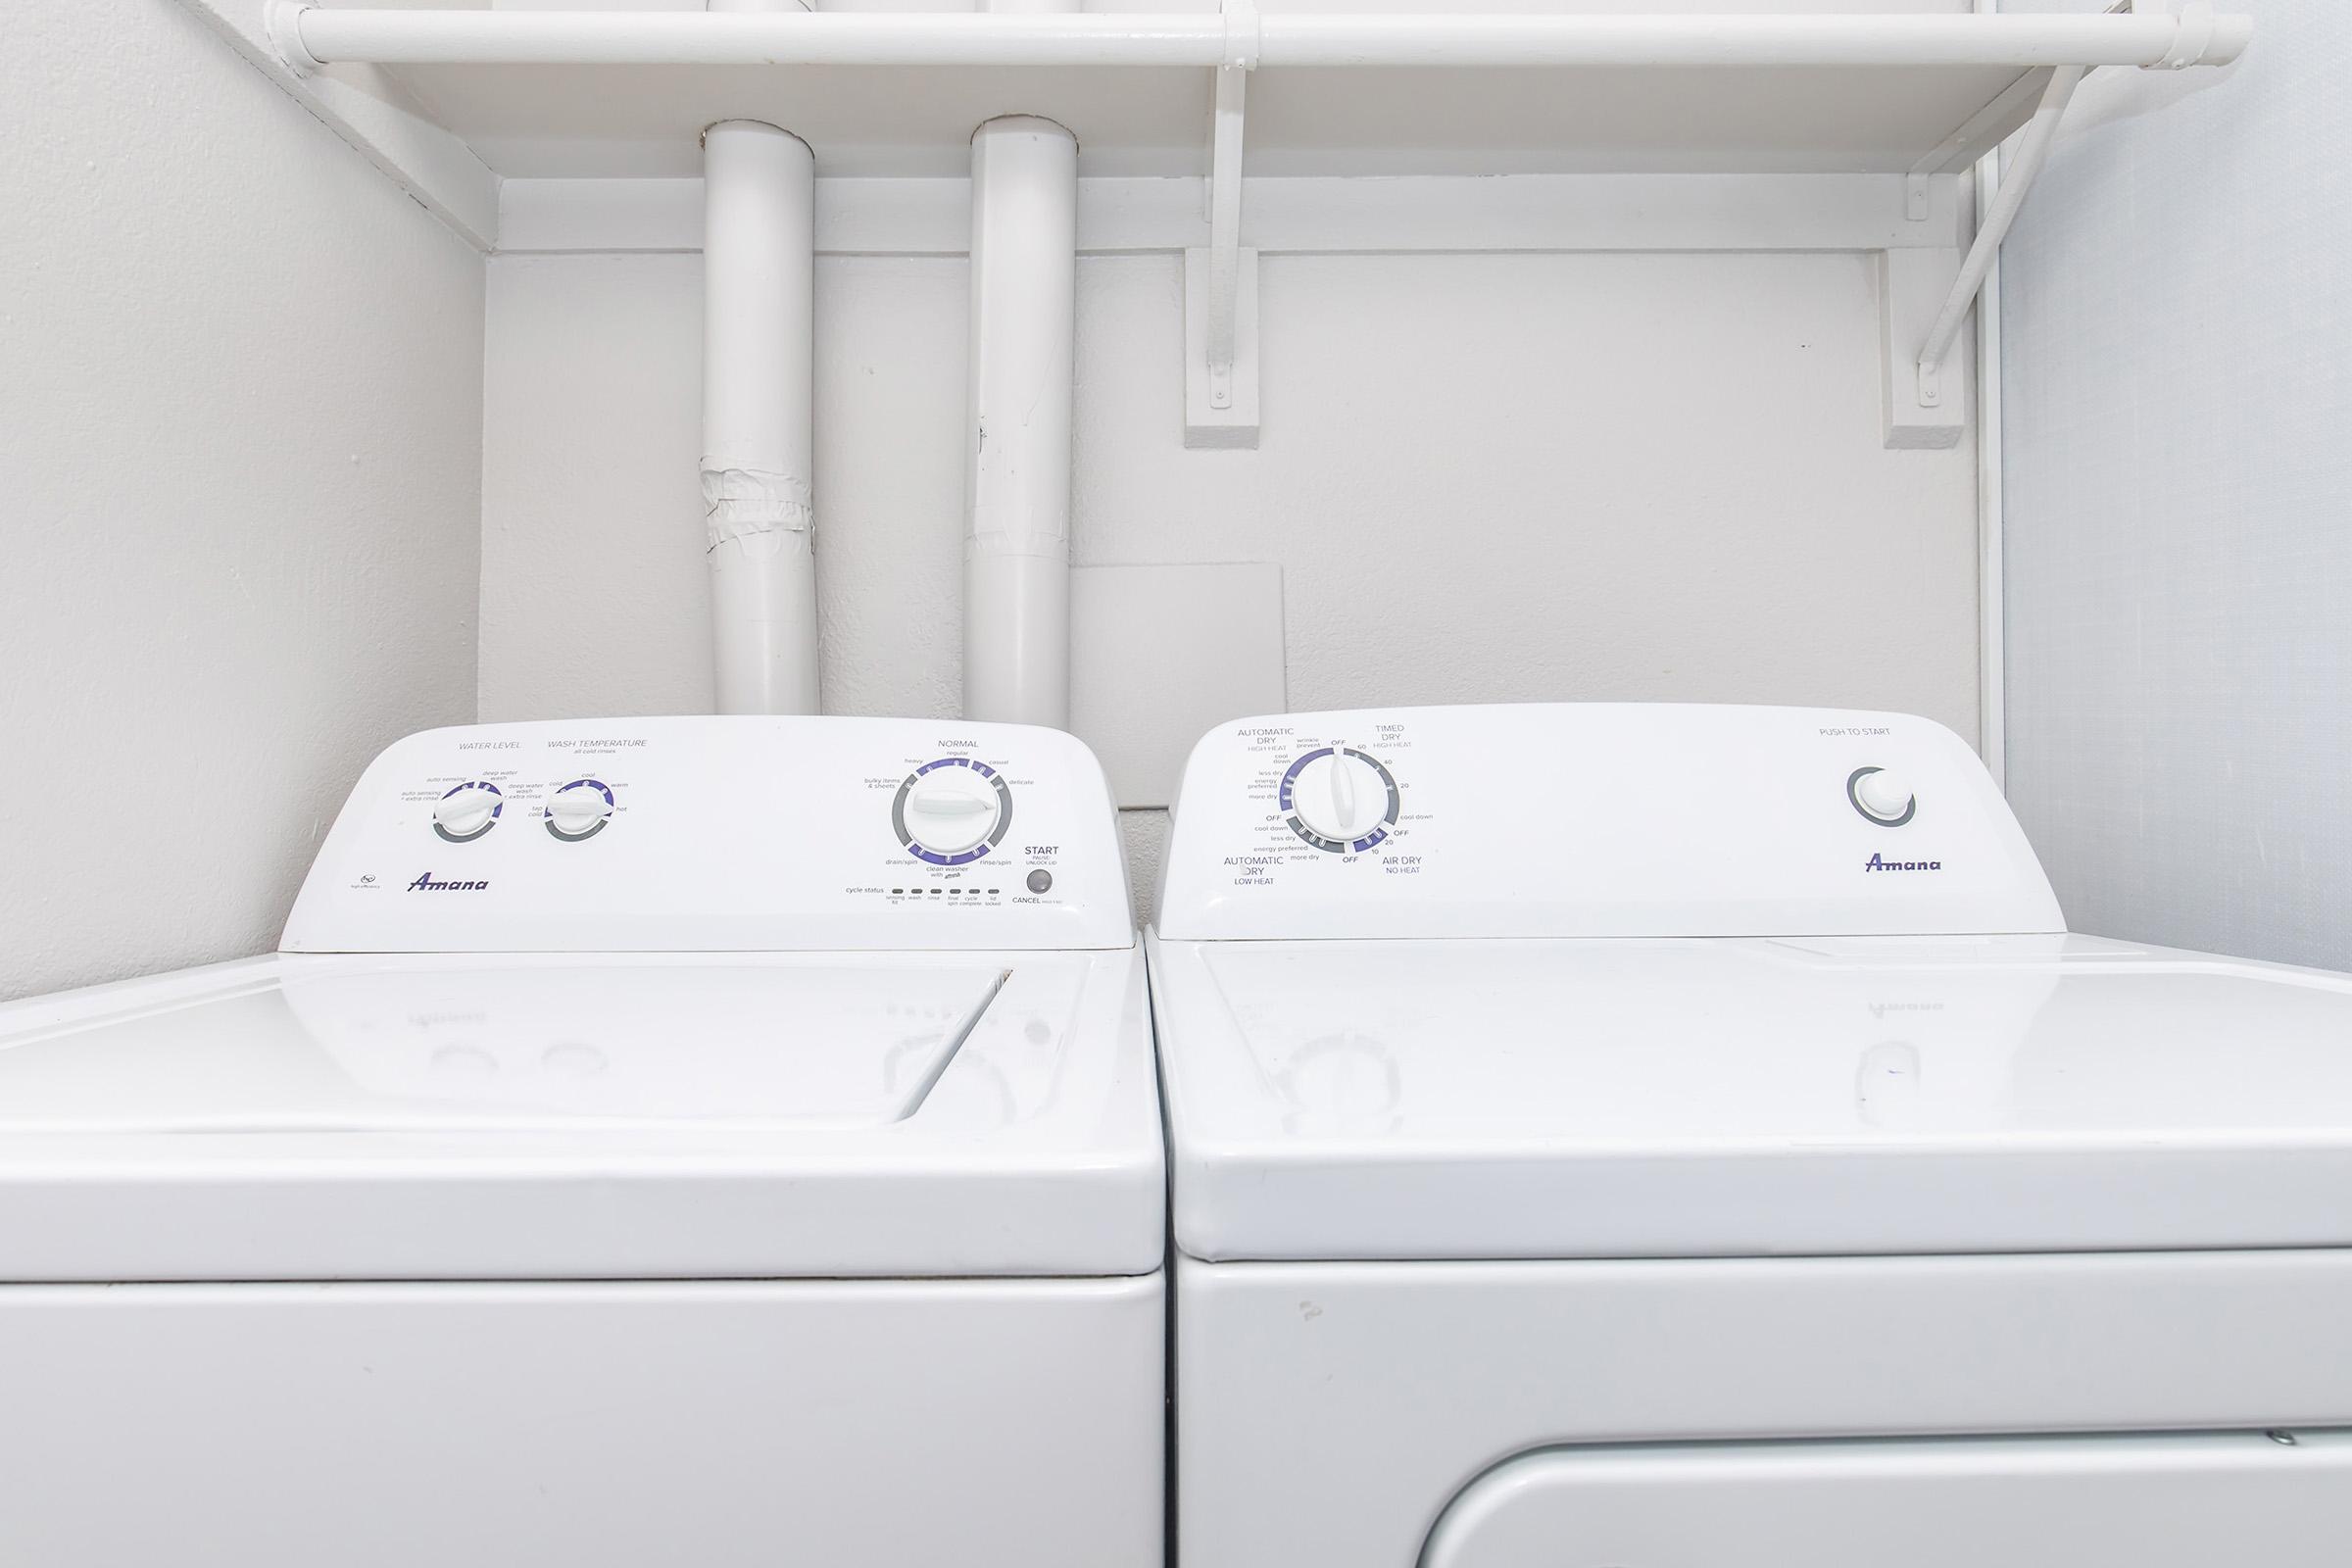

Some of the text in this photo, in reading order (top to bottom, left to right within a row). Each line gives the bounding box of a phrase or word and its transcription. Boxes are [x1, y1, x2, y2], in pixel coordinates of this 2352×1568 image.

[1025, 846, 1058, 855] START
[1224, 857, 1284, 865] AUTOMATIC
[1866, 853, 1941, 872] Amana
[407, 871, 489, 892] Amana
